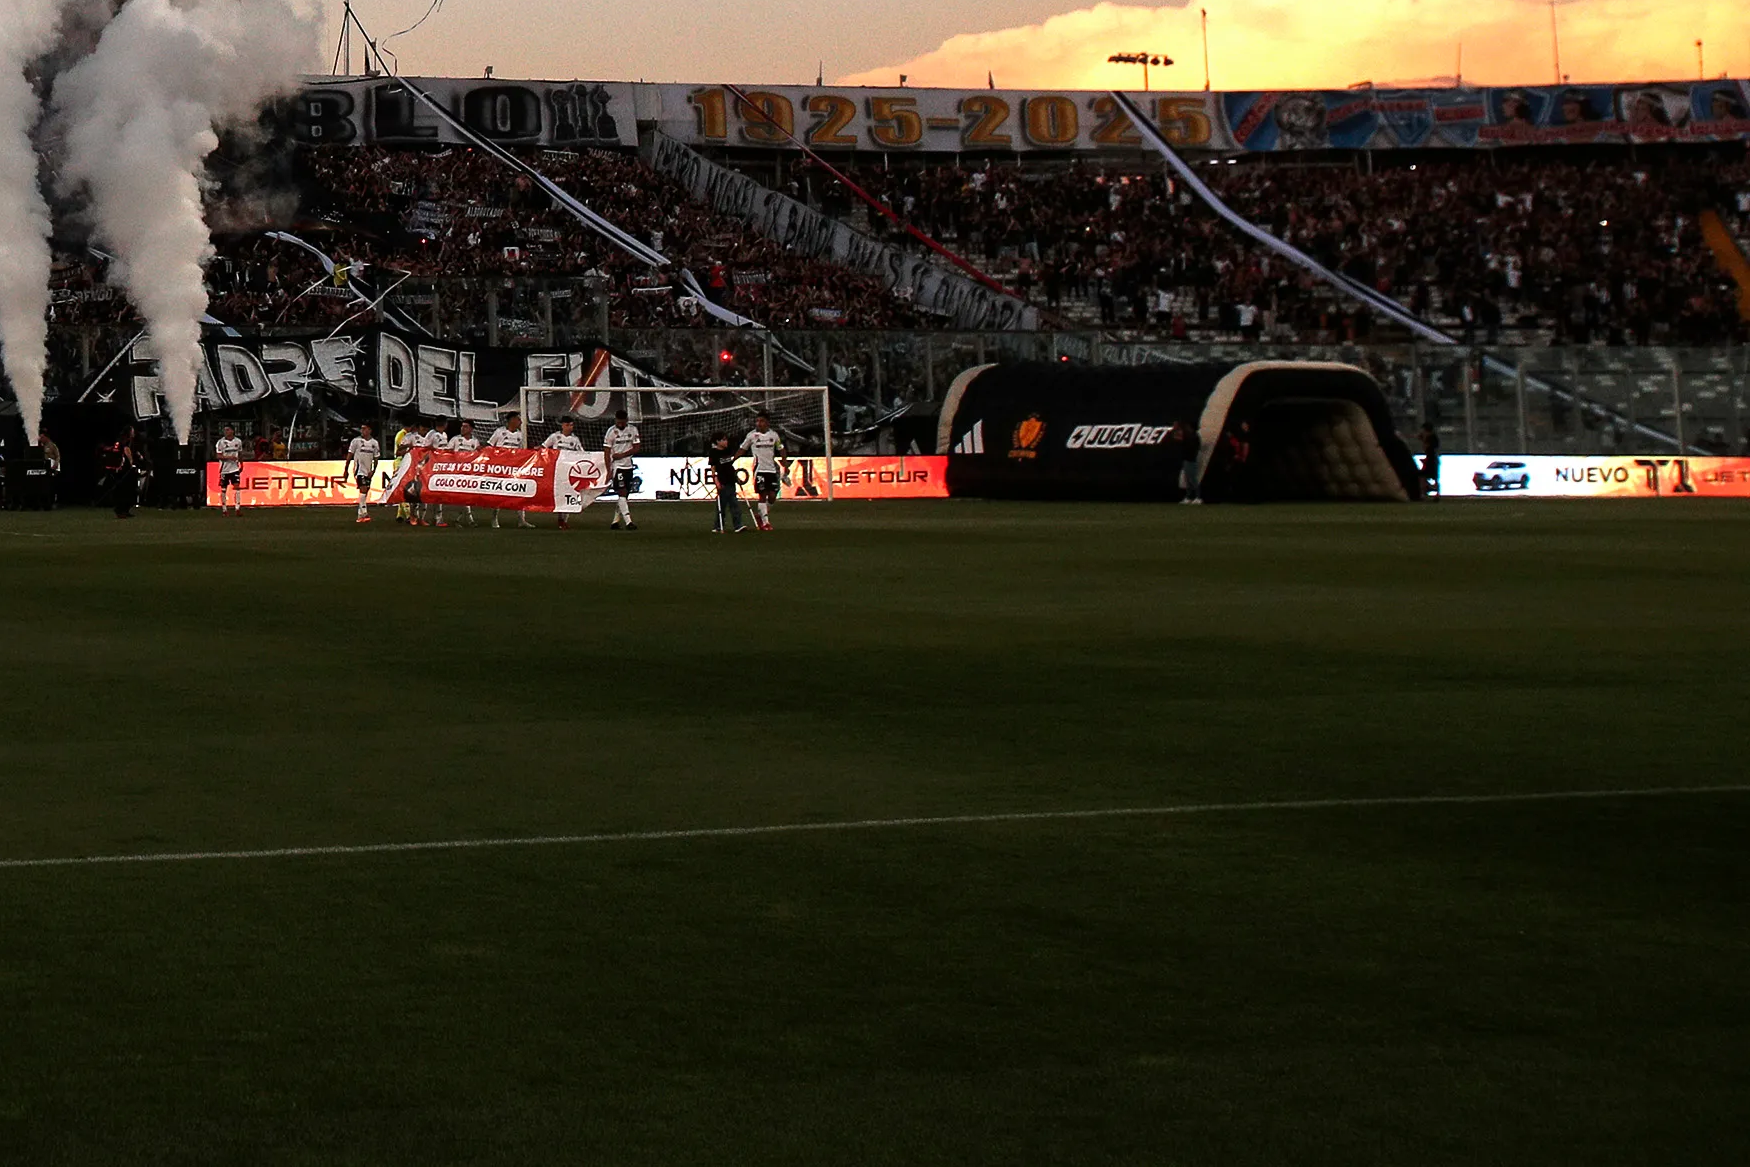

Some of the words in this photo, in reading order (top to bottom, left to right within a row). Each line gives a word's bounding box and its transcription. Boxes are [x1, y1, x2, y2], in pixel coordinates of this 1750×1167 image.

[691, 87, 1213, 148] 1925-2025
[378, 331, 500, 422] DEL
[473, 464, 485, 473] DE
[1556, 467, 1629, 483] NUEVO
[832, 471, 928, 483] JETOUR
[456, 479, 478, 488] COLO
[505, 483, 526, 493] CON
